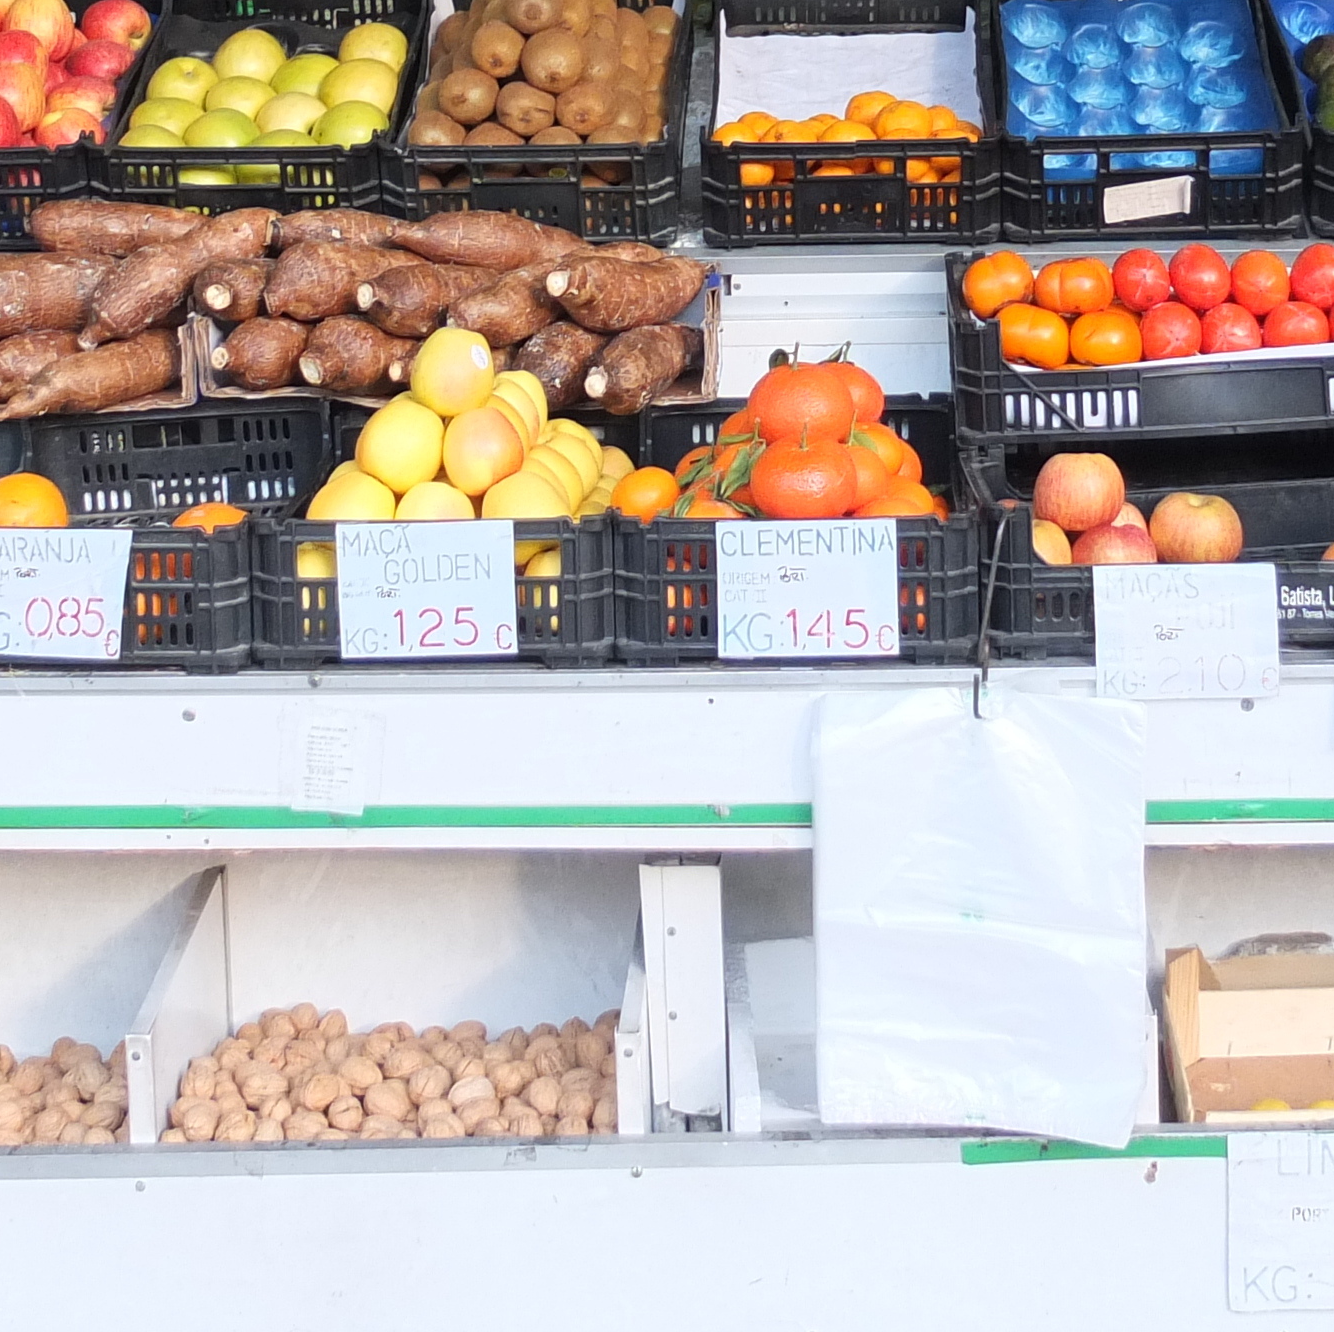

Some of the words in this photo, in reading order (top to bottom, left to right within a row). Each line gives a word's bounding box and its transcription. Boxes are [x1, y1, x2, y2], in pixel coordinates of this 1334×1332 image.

[341, 524, 412, 558] MAÇÃ
[720, 523, 894, 556] CLEMENTINA
[384, 553, 491, 585] GOLDEN
[1104, 567, 1199, 602] MAÇÃS
[24, 596, 105, 641] 0,85
[345, 628, 388, 654] KG:
[393, 606, 479, 652] 1,25
[723, 612, 784, 652] KG:
[785, 608, 870, 651] 1,45
[875, 624, 895, 652] €
[1243, 1265, 1313, 1303] KG:
